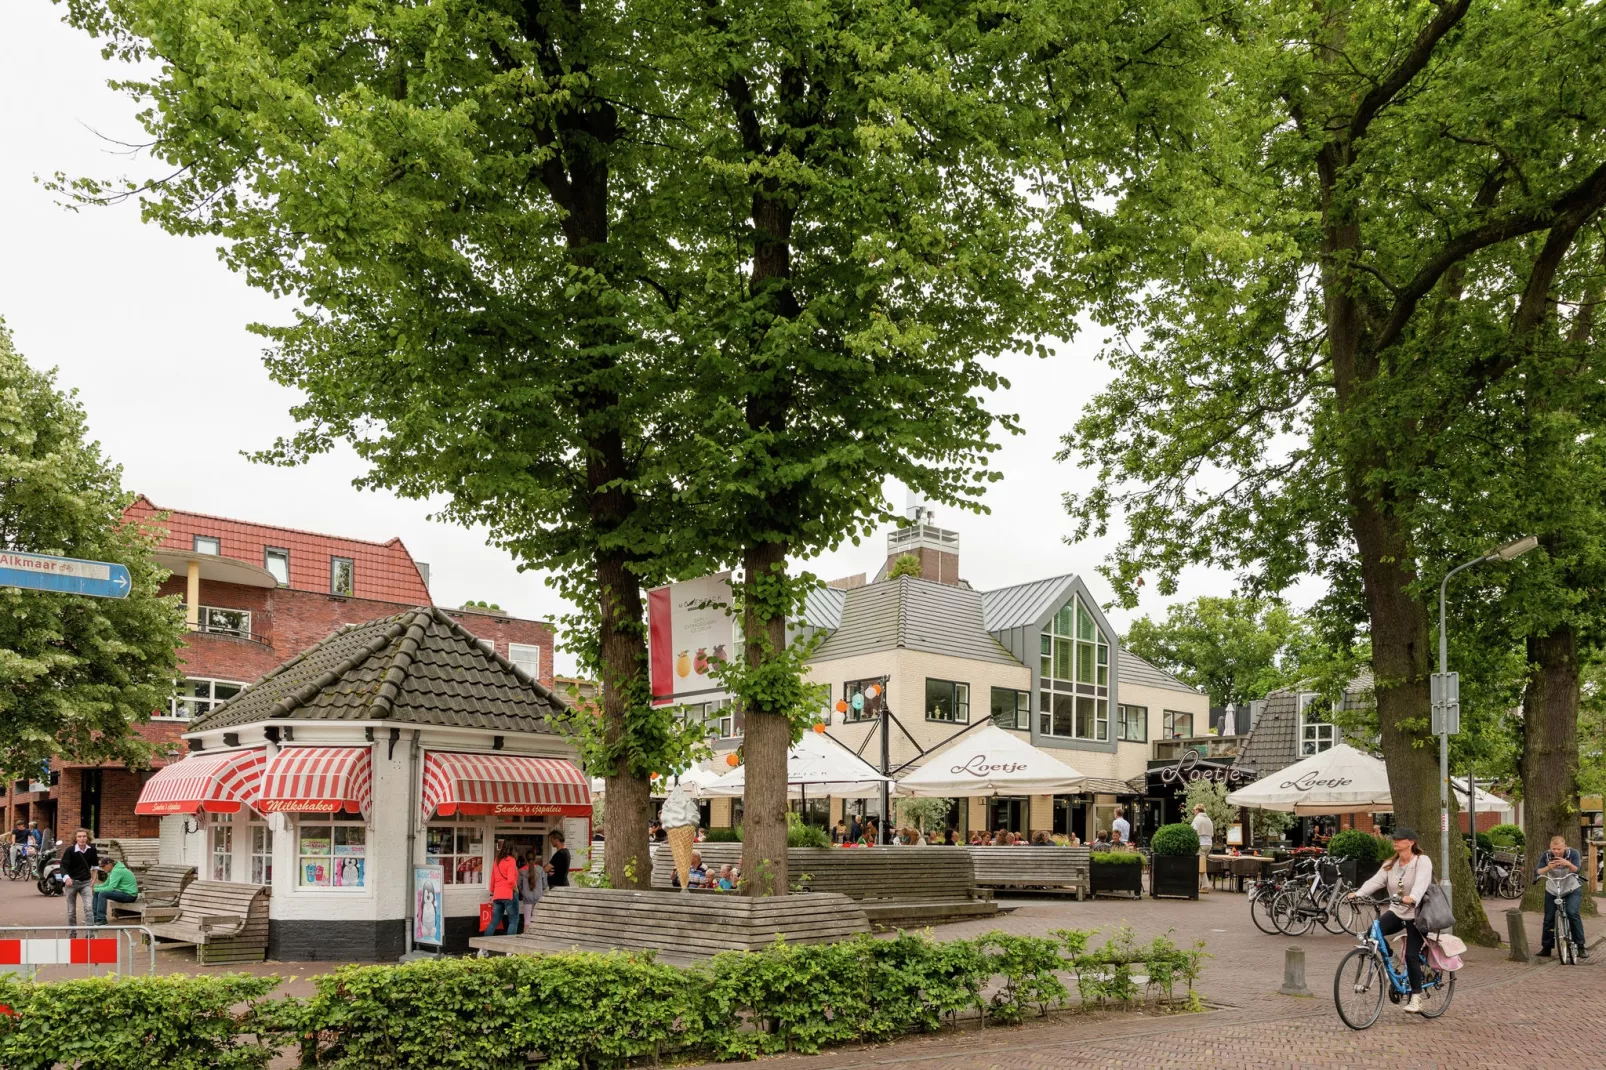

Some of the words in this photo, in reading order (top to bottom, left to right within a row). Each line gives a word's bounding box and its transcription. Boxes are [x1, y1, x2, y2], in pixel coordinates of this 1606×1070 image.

[0, 554, 57, 571] Alkmaar
[950, 754, 1027, 777] Loetje
[1161, 749, 1241, 789] Loetje
[1280, 771, 1353, 791] Loetje
[266, 800, 334, 811] Milkshakes
[494, 804, 530, 813] Sandra's
